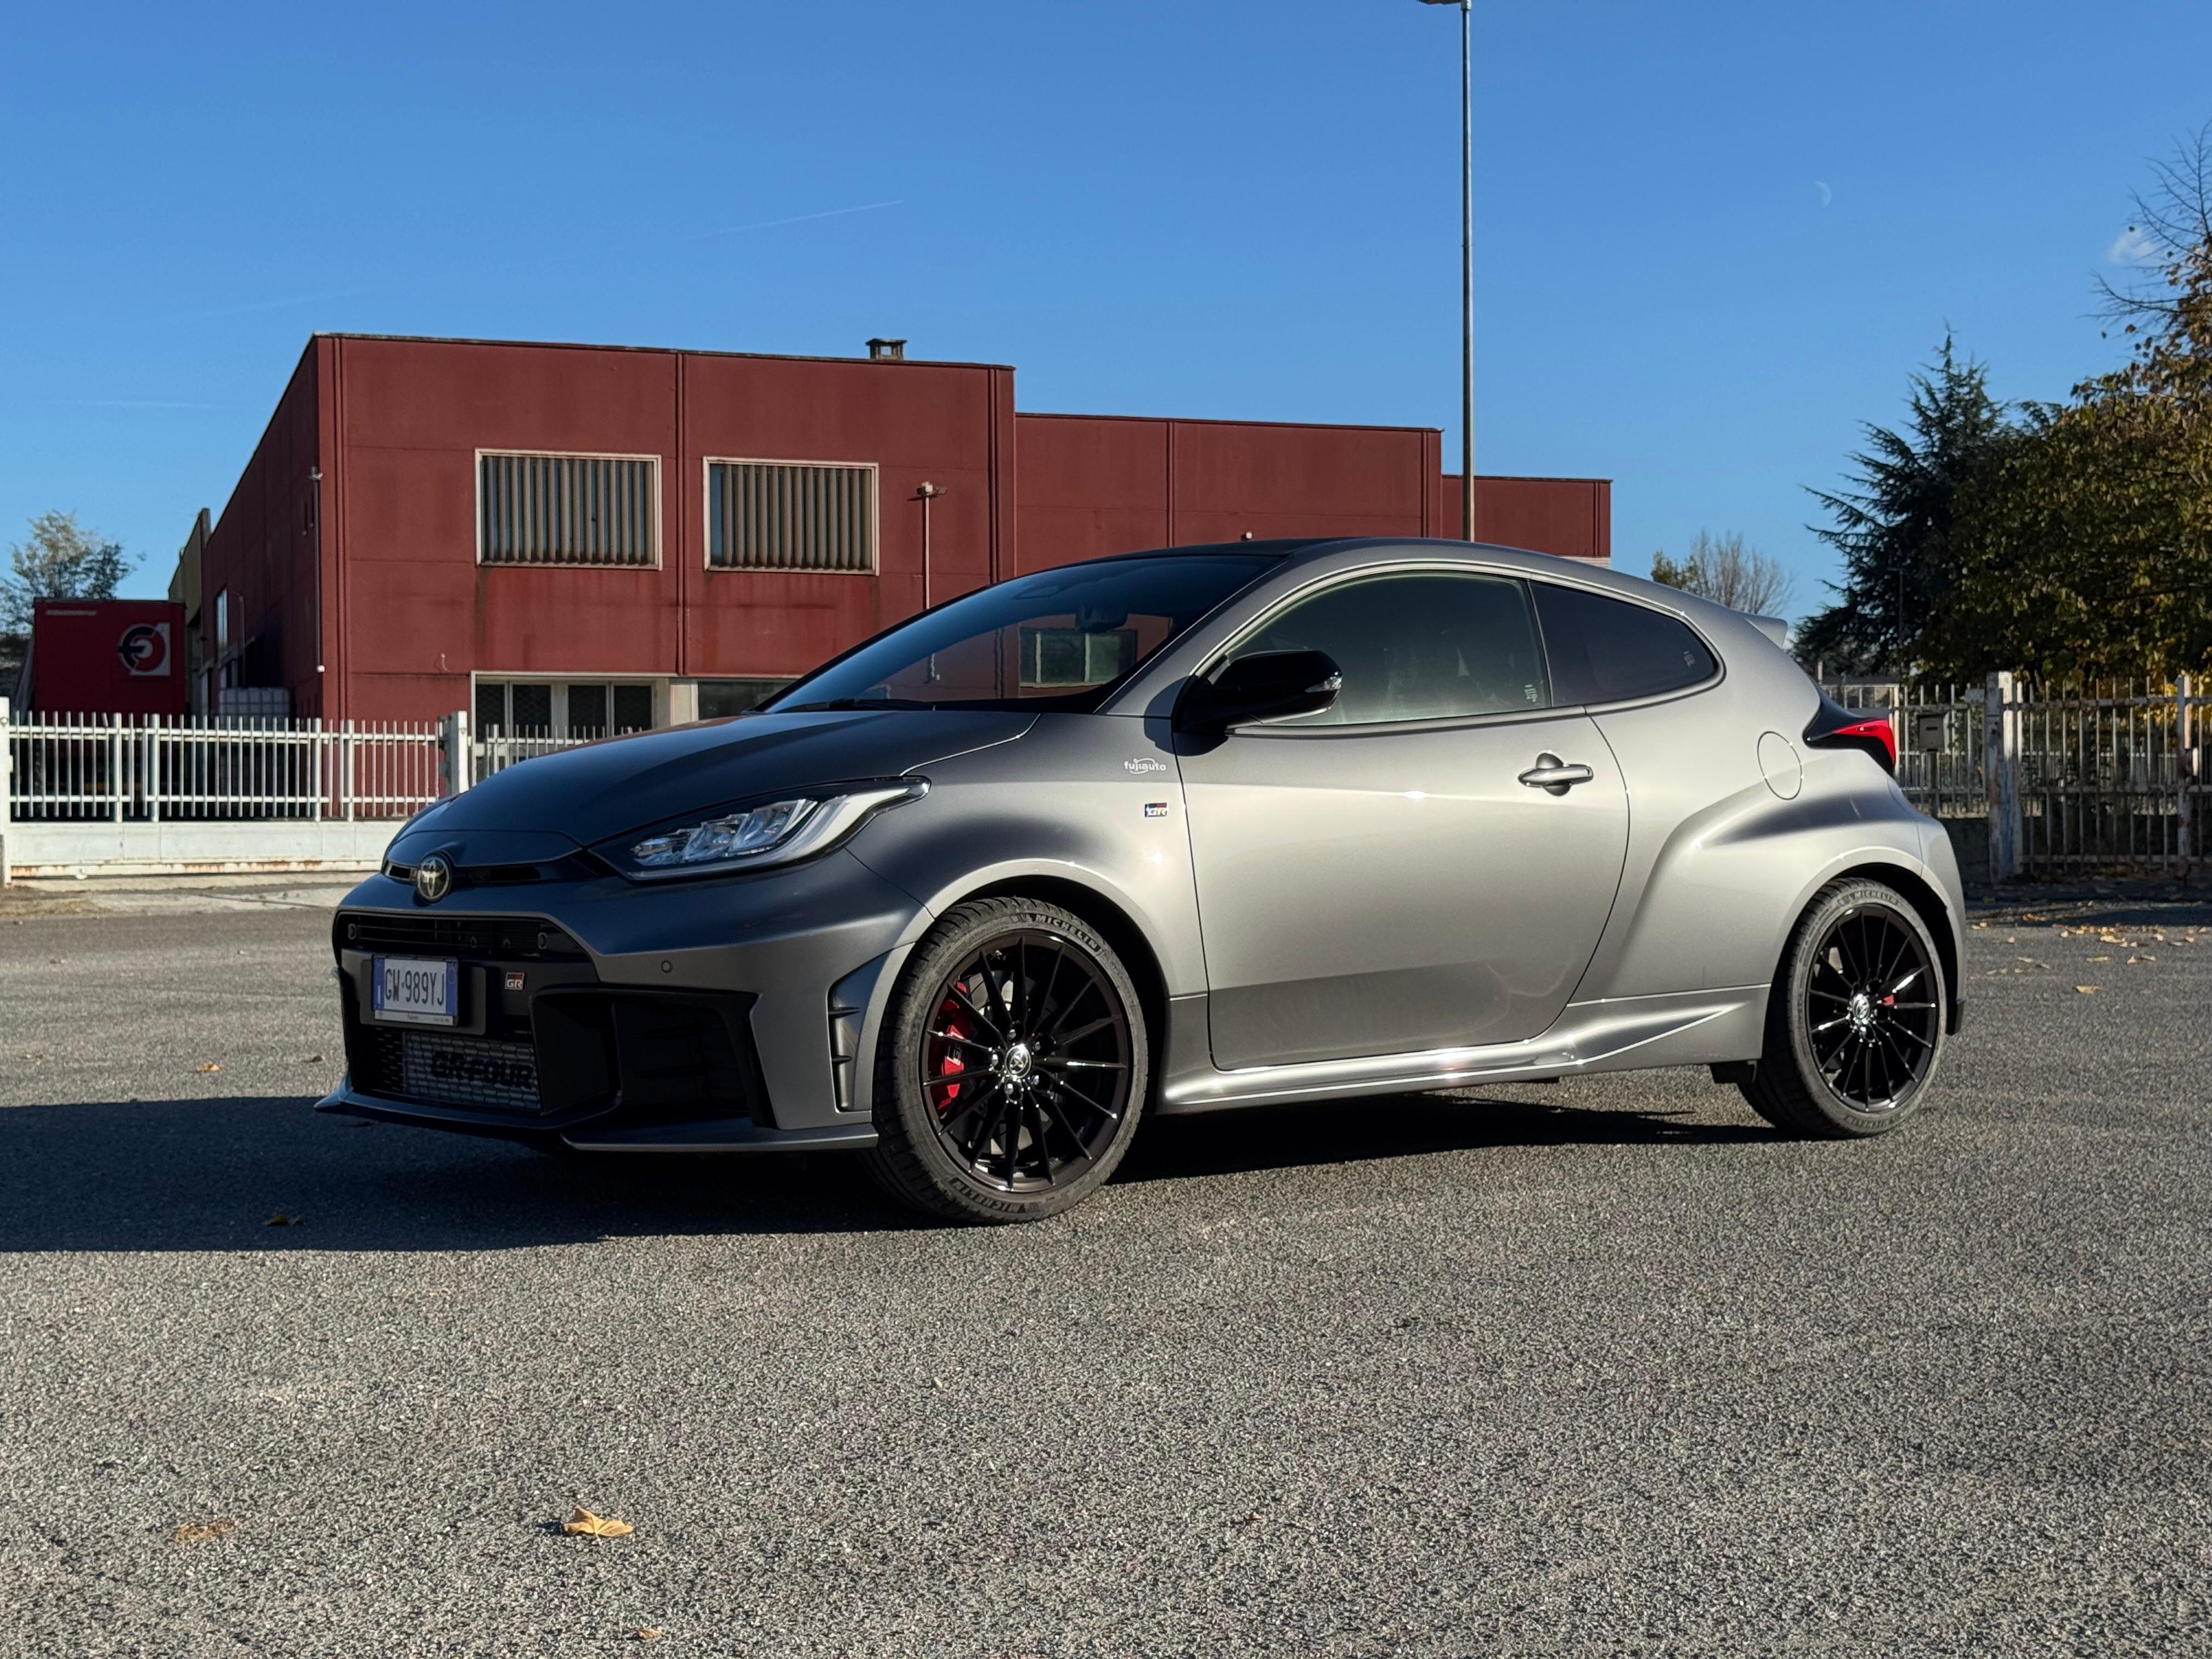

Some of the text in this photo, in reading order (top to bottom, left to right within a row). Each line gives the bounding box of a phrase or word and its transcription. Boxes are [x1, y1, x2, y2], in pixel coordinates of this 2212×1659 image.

[1124, 758, 1167, 772] fujiauto
[1147, 807, 1166, 816] GR
[1035, 914, 1099, 951] MICHELIN
[507, 979, 523, 988] GR
[953, 1179, 1019, 1212] MICHELIN
